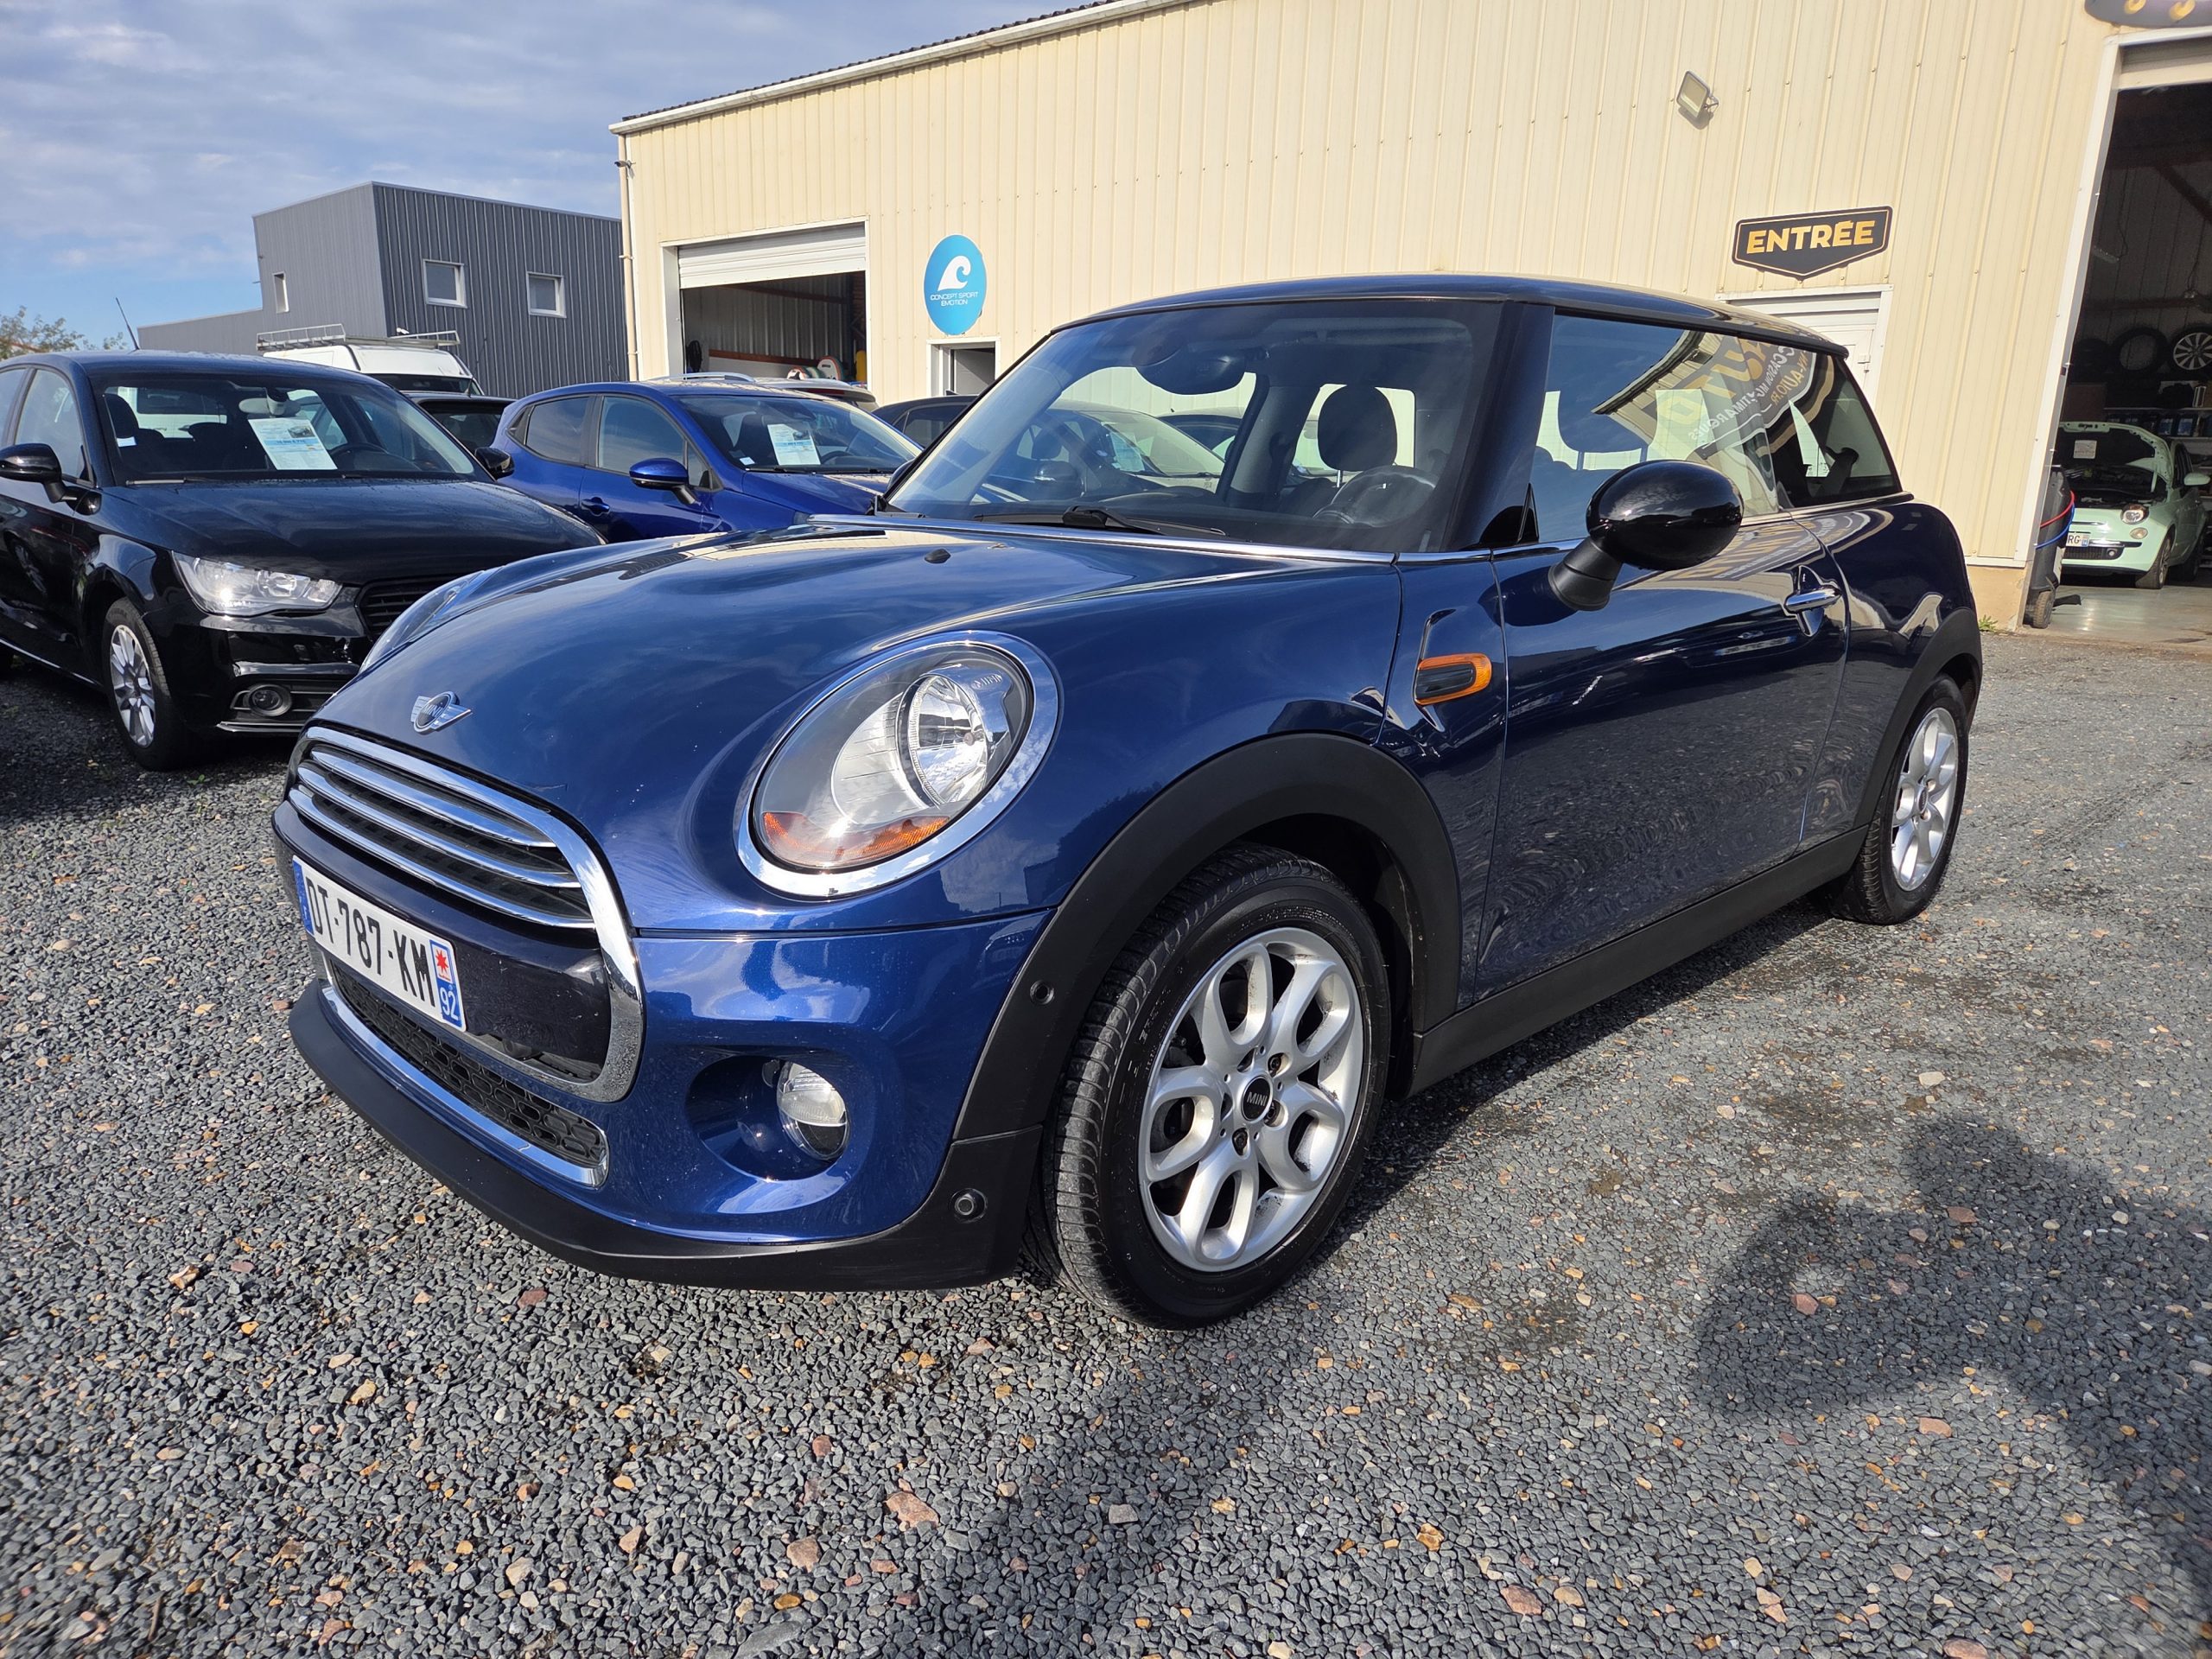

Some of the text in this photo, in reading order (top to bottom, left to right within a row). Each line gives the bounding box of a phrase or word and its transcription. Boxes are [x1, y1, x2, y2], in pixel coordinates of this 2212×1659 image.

[940, 298, 968, 307] EMOTION
[306, 877, 435, 1007] DT-787-KM
[440, 987, 459, 1020] 92
[1246, 1091, 1268, 1107] MINI
